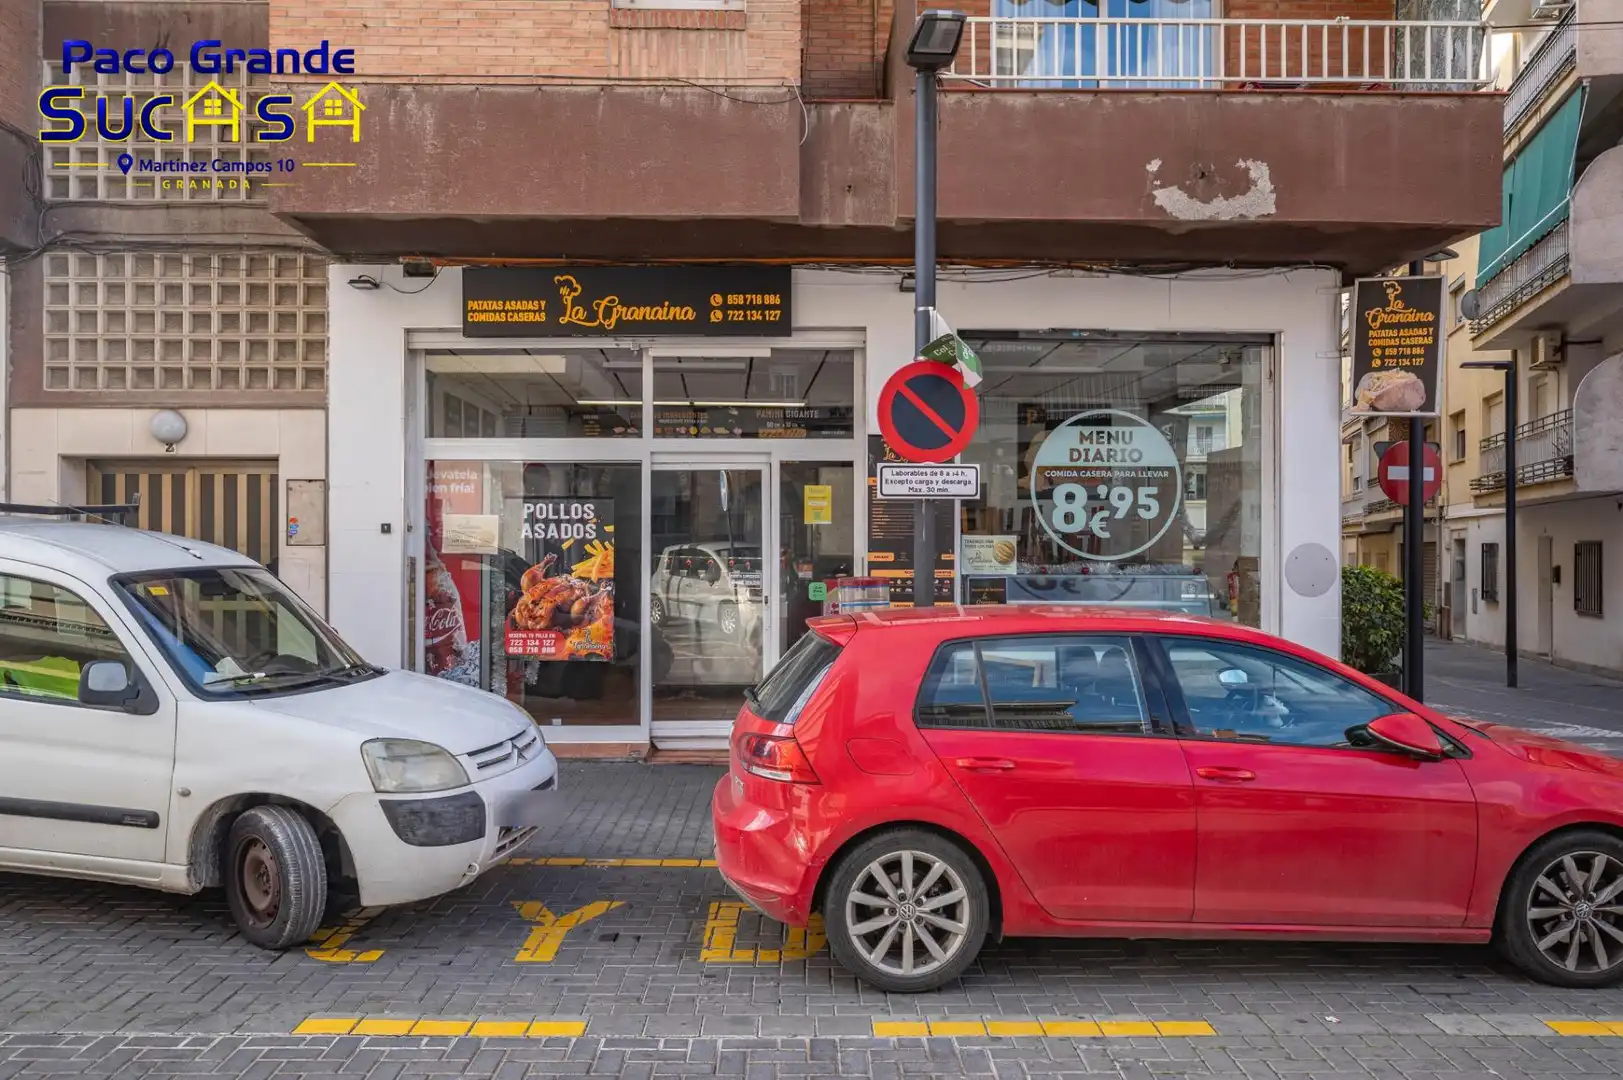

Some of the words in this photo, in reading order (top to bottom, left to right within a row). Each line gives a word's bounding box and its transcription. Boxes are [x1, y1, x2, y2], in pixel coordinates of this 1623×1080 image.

[727, 294, 743, 305] 858
[745, 294, 762, 305] 718
[763, 294, 781, 305] 886
[1385, 293, 1413, 312] La
[467, 300, 503, 311] PATATAS
[504, 300, 537, 311] ASADAS
[537, 300, 546, 311] Y
[467, 312, 506, 322] COMIDAS
[507, 312, 546, 322] CASERAS
[559, 294, 597, 327] La
[593, 295, 696, 329] Granaina
[727, 310, 745, 321] 722
[746, 310, 763, 321] 134
[764, 310, 781, 321] 127
[1365, 307, 1435, 329] Granaina
[1368, 329, 1398, 338] PATATAS
[1399, 327, 1428, 336] ASADAS
[1428, 327, 1434, 335] Y
[1368, 338, 1400, 346] COMIDAS
[1400, 336, 1433, 345] CASERAS
[1384, 358, 1397, 367] 722
[1398, 358, 1411, 366] 134
[1412, 358, 1425, 366] 127
[1078, 430, 1134, 445] MENU
[1069, 448, 1143, 463] DIARIO
[1044, 470, 1078, 478] COMIDA
[1080, 470, 1112, 478] CASERA
[1114, 470, 1136, 478] PARA
[1138, 470, 1169, 478] LLEVAR
[884, 478, 913, 486] Excepto
[523, 503, 596, 520] POLLOS
[520, 523, 597, 539] ASADOS
